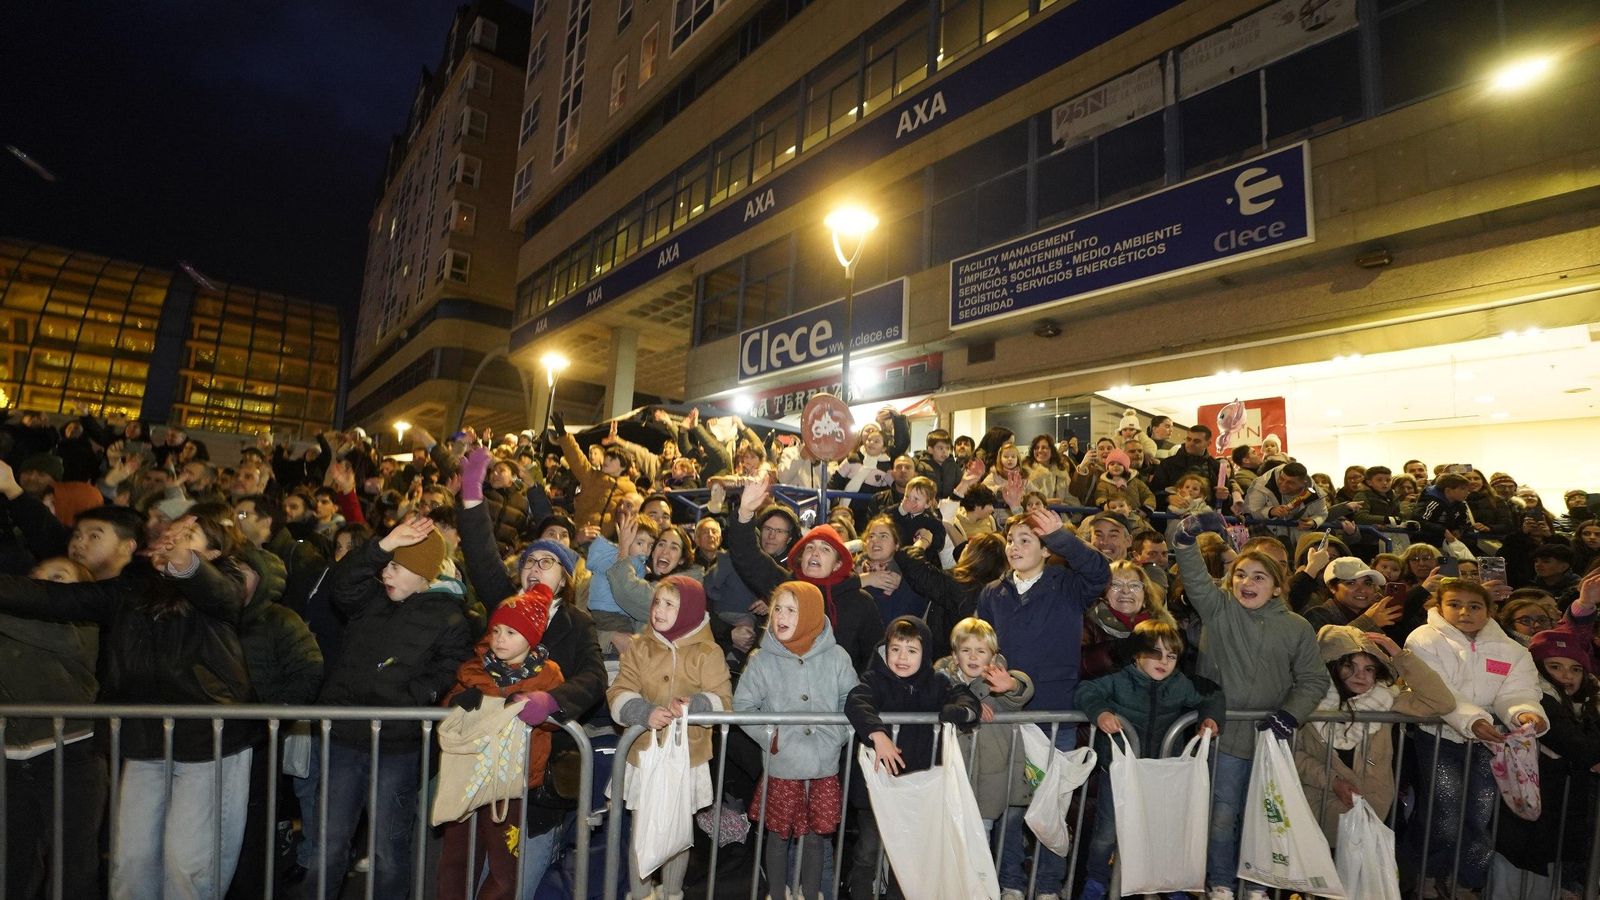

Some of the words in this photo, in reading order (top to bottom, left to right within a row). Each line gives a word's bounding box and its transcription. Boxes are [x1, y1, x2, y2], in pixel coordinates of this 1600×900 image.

[895, 91, 947, 139] AXA
[744, 188, 775, 222] AXA
[960, 254, 999, 275] FACILITY
[1001, 229, 1076, 262] MANAGEMENT
[1214, 221, 1286, 252] Clece
[658, 242, 680, 269] AXA
[959, 275, 1008, 297] SERVICIOS
[1010, 260, 1063, 283] SOCIALES
[1072, 245, 1111, 265] MEDIO
[1113, 223, 1183, 253] AMBIENTE
[959, 266, 1001, 286] LIMPIEZA
[1008, 235, 1098, 271] MANTENIMIENTO
[959, 287, 1008, 309] LOGÍSTICA
[1016, 269, 1073, 293] SERVICIOS
[1075, 243, 1166, 277] ENERGÉTICOS
[586, 285, 603, 307] AXA
[959, 298, 1014, 320] SEGURIDAD
[535, 317, 548, 335] AXA
[829, 325, 900, 354] ww.clece.es
[741, 319, 833, 376] Clece
